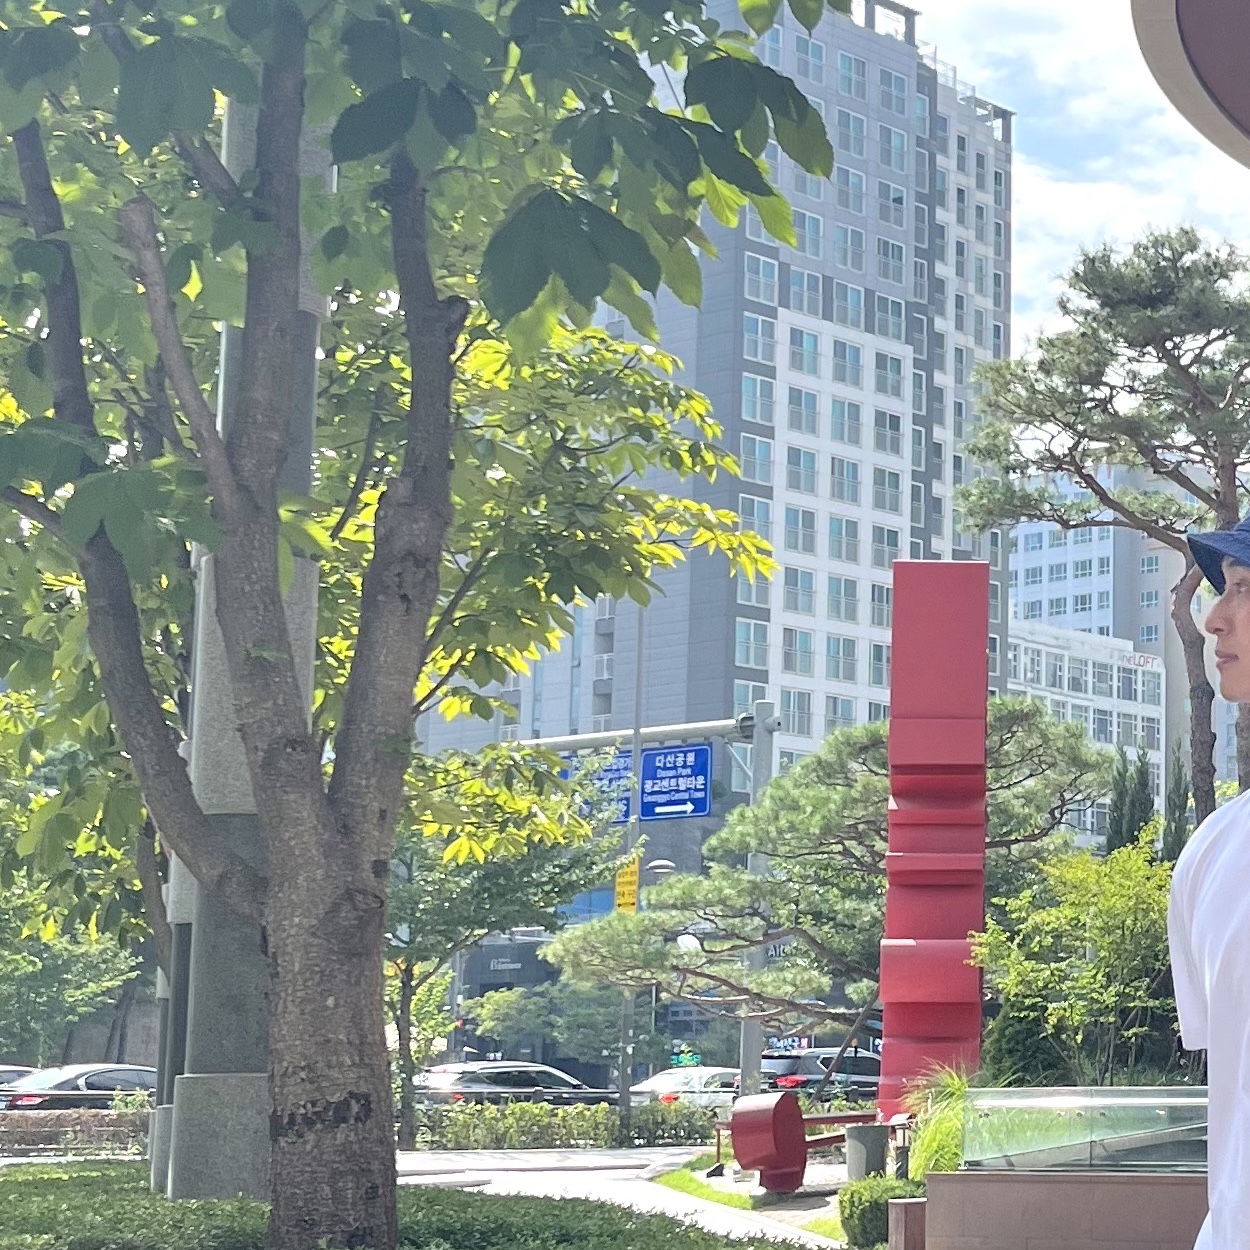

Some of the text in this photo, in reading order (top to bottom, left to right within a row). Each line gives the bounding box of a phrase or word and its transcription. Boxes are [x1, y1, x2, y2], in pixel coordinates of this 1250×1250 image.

[656, 752, 695, 767] 다산공원
[656, 766, 692, 778] Dasan Park
[644, 775, 705, 792] 광교센트럴타운
